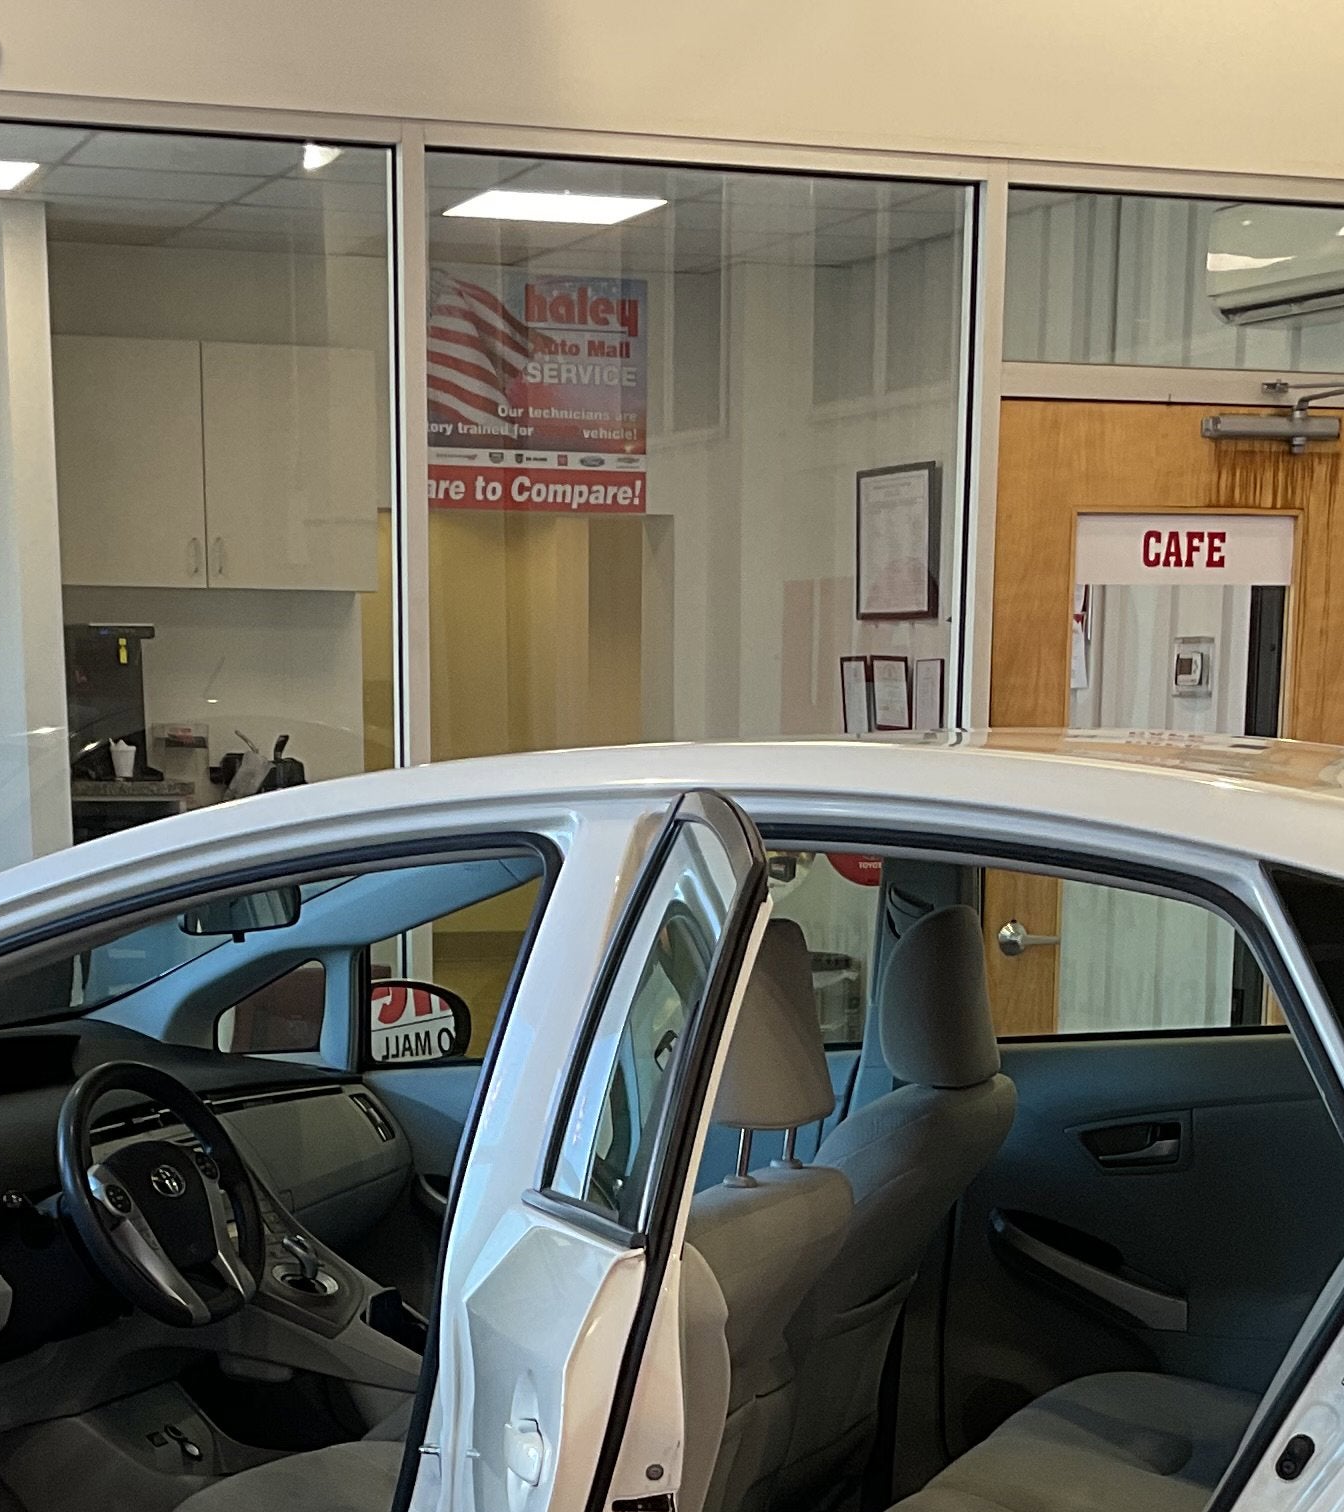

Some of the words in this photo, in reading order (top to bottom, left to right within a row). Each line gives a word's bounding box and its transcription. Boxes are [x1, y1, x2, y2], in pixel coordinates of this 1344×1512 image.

[524, 283, 639, 337] haley
[533, 339, 580, 357] Auto
[587, 340, 631, 359] Mall
[526, 362, 637, 387] SERVICE
[497, 405, 524, 418] Our
[528, 406, 609, 421] technicians
[614, 410, 637, 422] are
[457, 422, 509, 436] trained
[513, 423, 534, 438] for
[582, 427, 637, 441] vehicle!
[475, 475, 503, 500] to
[511, 475, 642, 509] Compare!
[1142, 530, 1226, 568] CAFE
